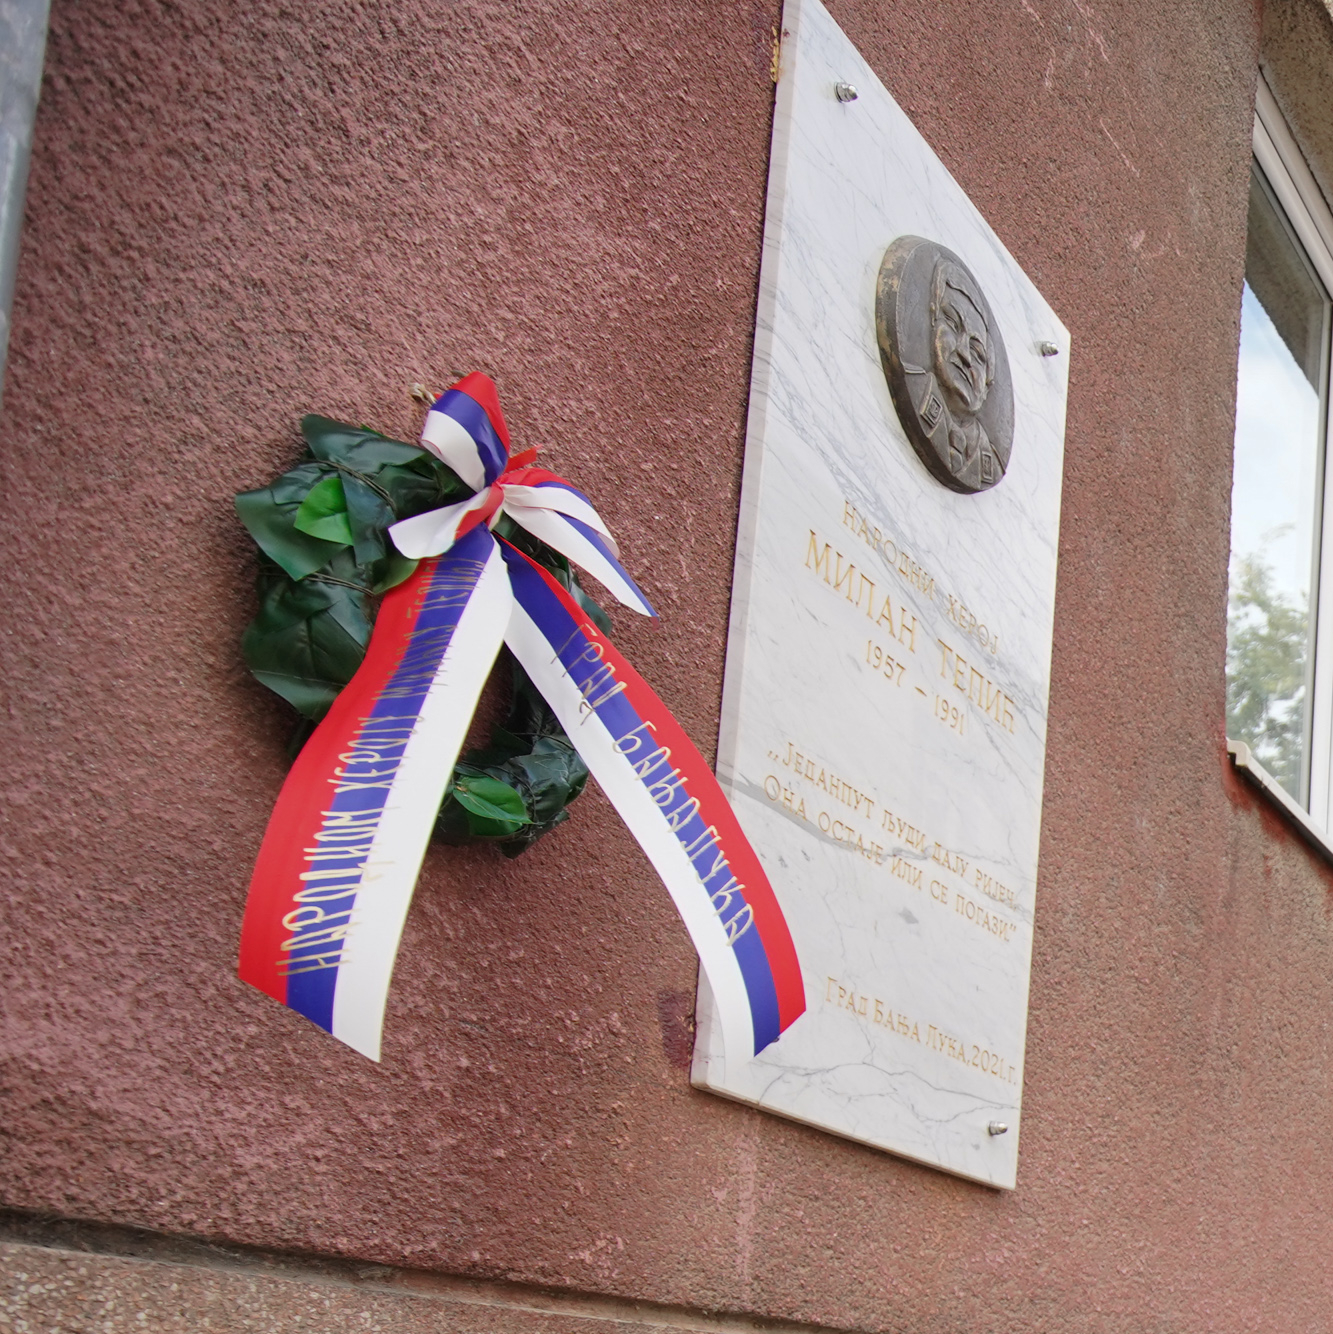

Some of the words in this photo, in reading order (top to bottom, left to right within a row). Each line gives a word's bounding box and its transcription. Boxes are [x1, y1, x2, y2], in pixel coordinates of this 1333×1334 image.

[842, 499, 936, 601] НАРОДНИ
[947, 593, 999, 655] ХЕРОЈ
[804, 528, 918, 655] МИЛАН
[937, 638, 1016, 735] ТЕПИЋ
[865, 639, 906, 688] 1957
[934, 694, 965, 736] 1991
[818, 811, 885, 867] ОСТАЈЕ
[890, 853, 924, 891] ИЛИ
[929, 879, 949, 905] СЕ
[882, 808, 926, 854] ЉУДИ
[931, 841, 970, 878] ДАЈУ
